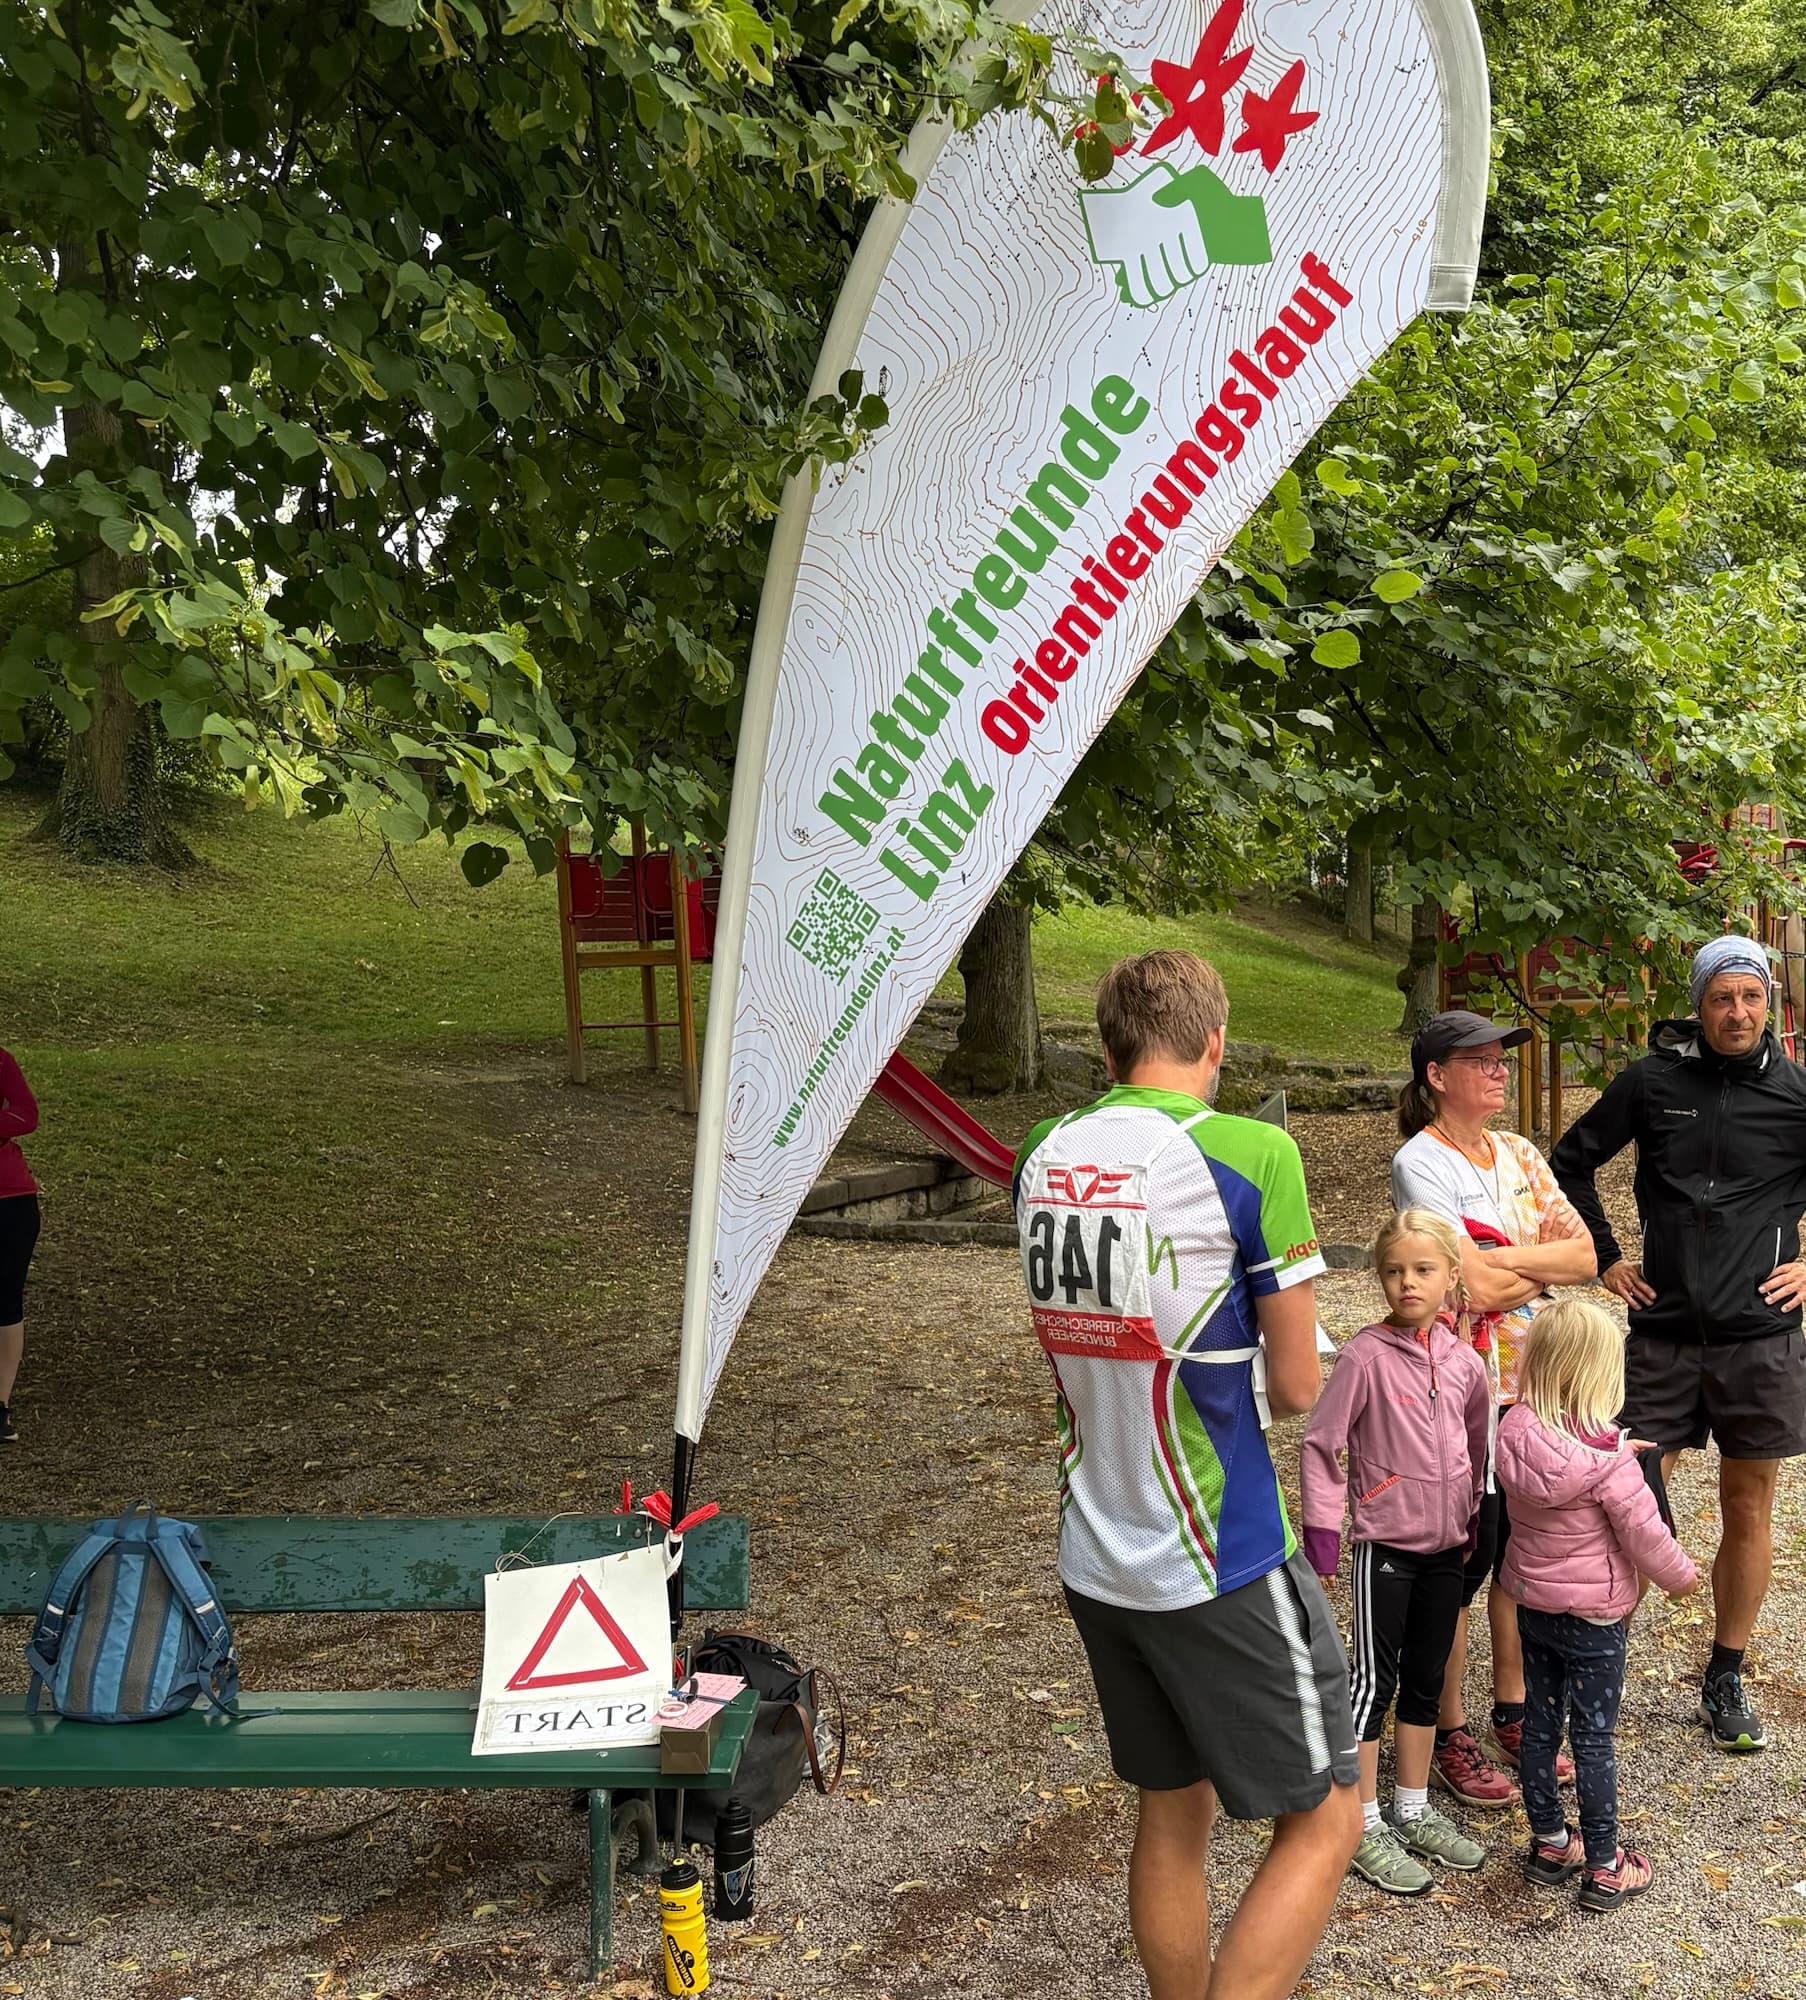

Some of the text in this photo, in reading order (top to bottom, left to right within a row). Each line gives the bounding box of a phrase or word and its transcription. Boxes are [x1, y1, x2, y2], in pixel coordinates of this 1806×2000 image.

[818, 375, 1149, 846] Naturfreunde
[879, 252, 1353, 901] Linz Orientierungslauf
[773, 926, 906, 1148] www.naturfreundelinz.at
